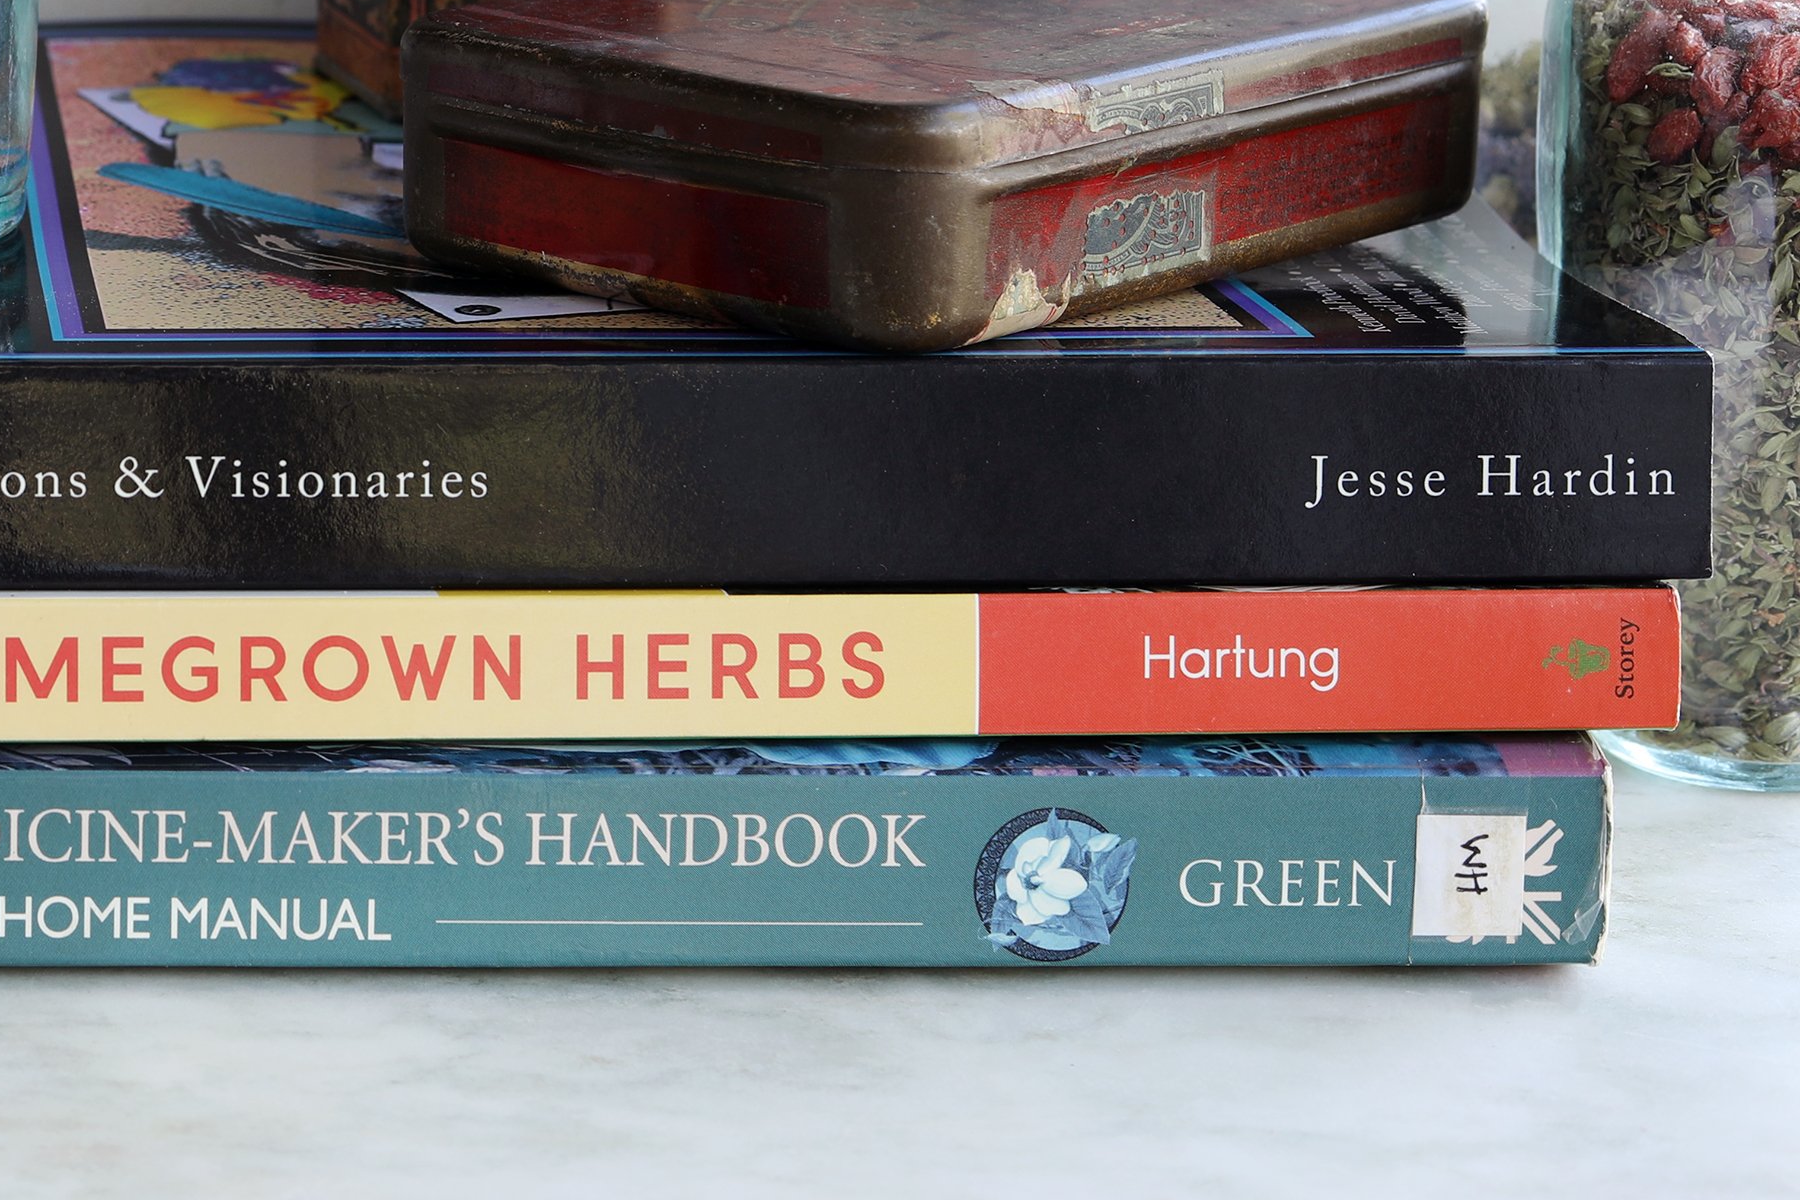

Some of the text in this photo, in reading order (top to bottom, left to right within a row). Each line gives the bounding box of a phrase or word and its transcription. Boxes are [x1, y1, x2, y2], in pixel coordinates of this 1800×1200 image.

[114, 456, 164, 499] &
[185, 456, 489, 499] Visionaries
[1305, 453, 1677, 509] Jesse Hardin
[575, 631, 886, 701] HERBS
[1143, 634, 1340, 692] Hartung
[1615, 617, 1640, 700] Storey
[525, 813, 927, 869] HANDBOOK
[1178, 858, 1396, 908] GREEN
[170, 897, 392, 941] MANUAL
